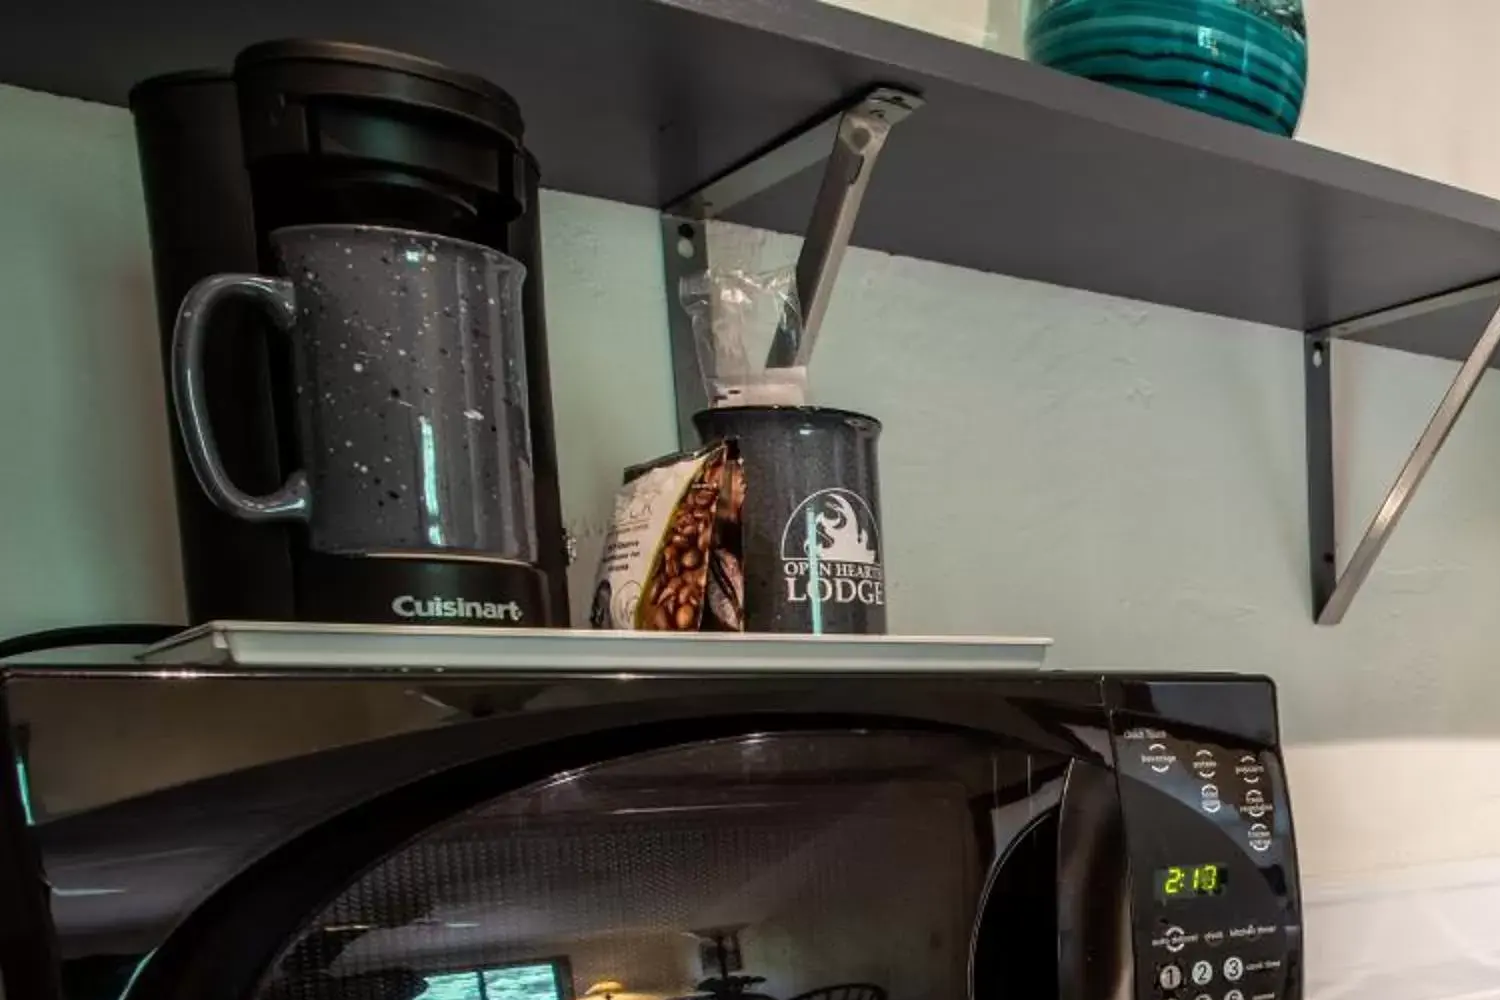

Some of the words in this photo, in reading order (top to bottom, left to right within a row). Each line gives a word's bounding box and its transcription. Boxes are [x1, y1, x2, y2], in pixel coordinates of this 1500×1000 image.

[784, 561, 832, 577] OPN
[784, 577, 884, 605] LODGE
[391, 595, 520, 621] Cuisinart
[1140, 753, 1177, 764] beverage
[1198, 964, 1207, 981] 2
[1229, 960, 1239, 978] 3
